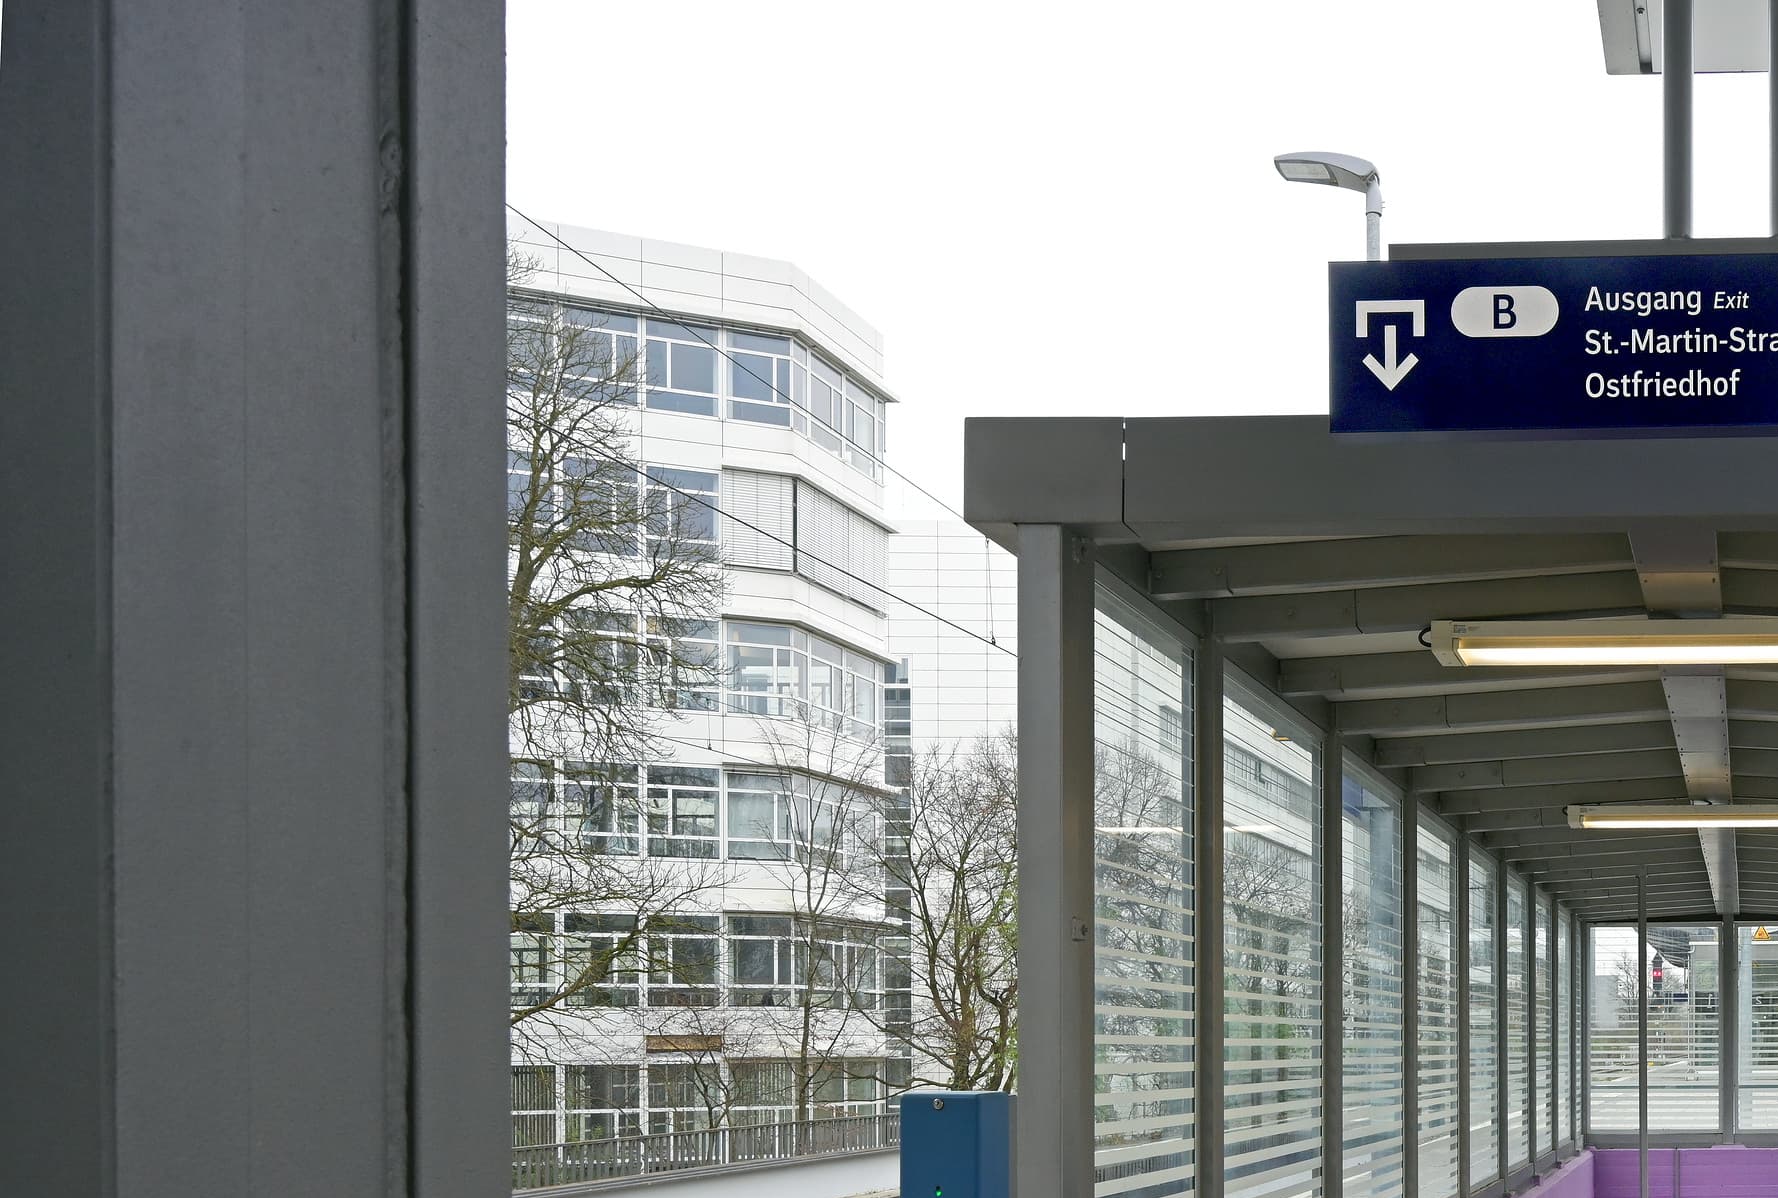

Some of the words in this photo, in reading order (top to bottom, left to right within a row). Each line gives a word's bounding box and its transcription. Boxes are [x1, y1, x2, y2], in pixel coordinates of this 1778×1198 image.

[1493, 293, 1517, 330] B
[1584, 286, 1702, 317] Ausgang
[1713, 290, 1750, 310] Exit
[1585, 369, 1741, 398] Ostfriedhof
